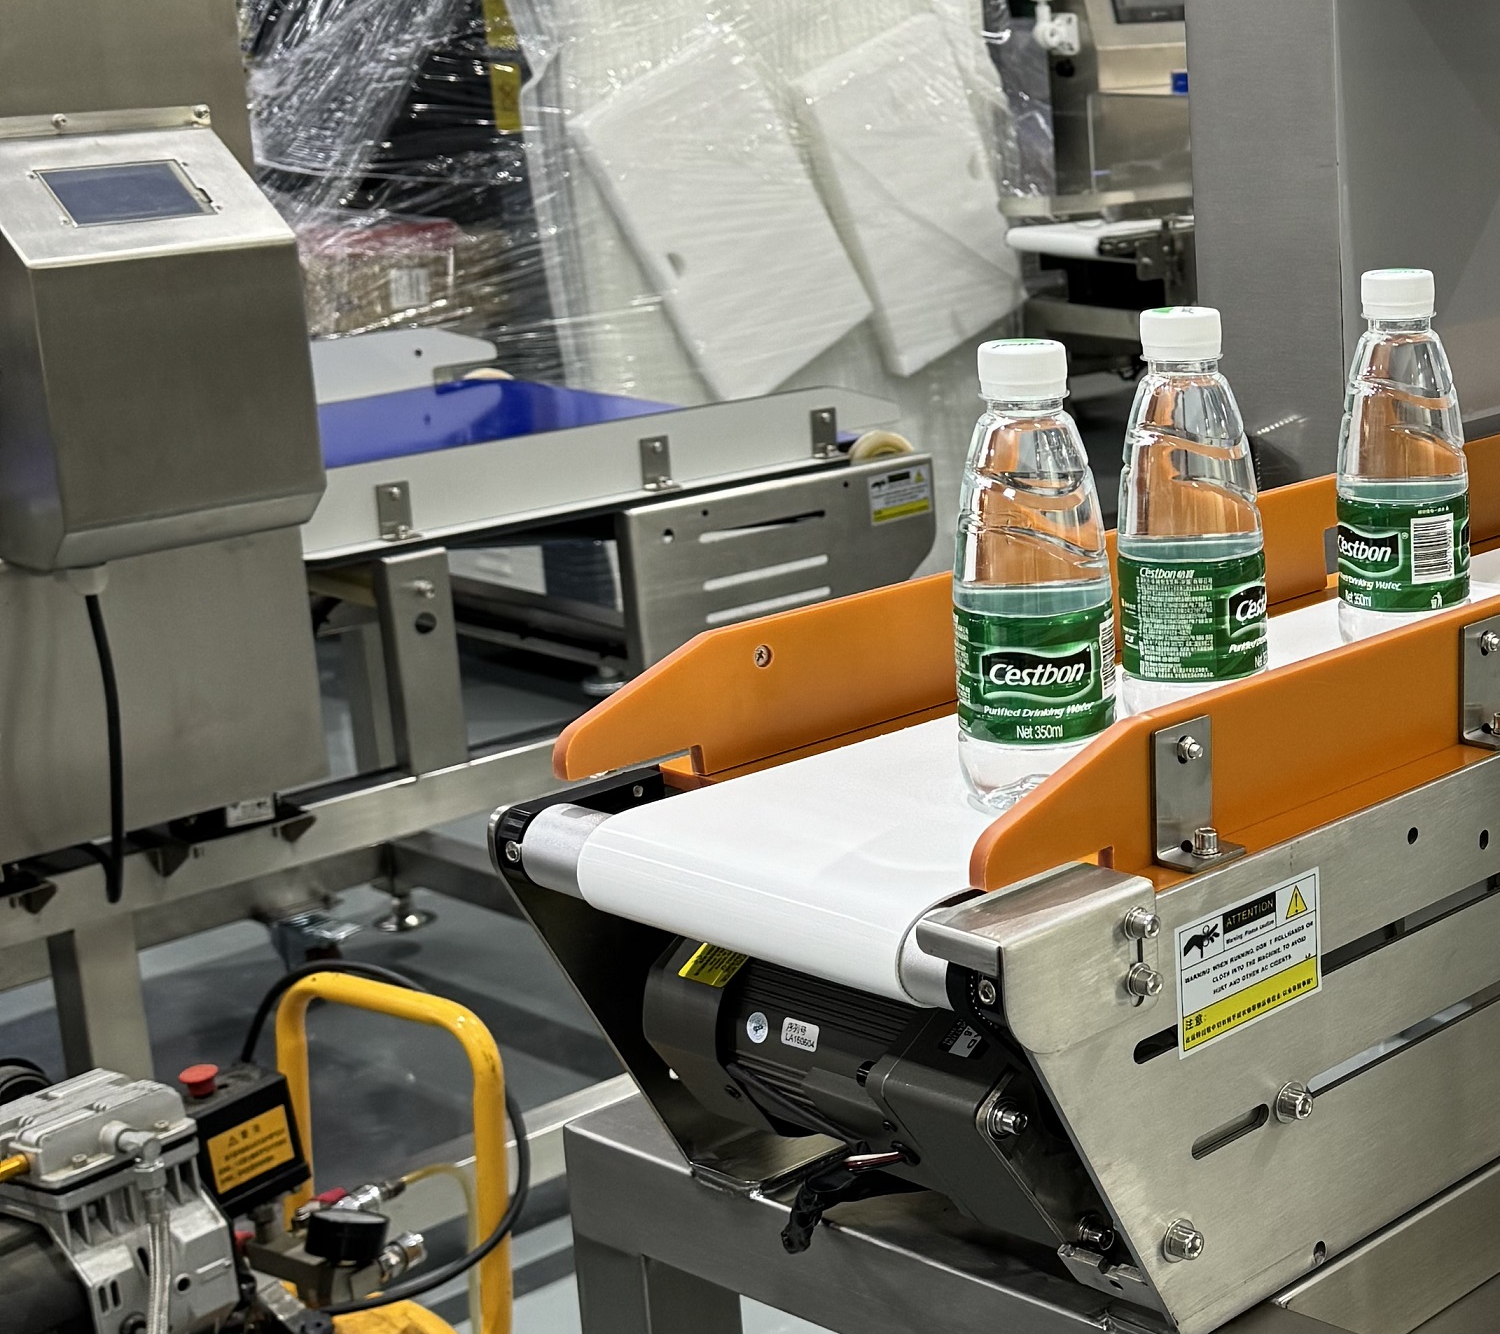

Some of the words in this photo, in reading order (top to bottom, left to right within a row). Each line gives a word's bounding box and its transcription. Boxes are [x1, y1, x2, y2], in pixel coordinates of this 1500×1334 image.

[983, 705, 1020, 717] Purified
[1022, 707, 1065, 719] Drinking
[1066, 701, 1095, 716] Water
[1016, 724, 1033, 739] Net
[1034, 724, 1064, 739] 350ml
[1226, 898, 1274, 927] ATTENTION
